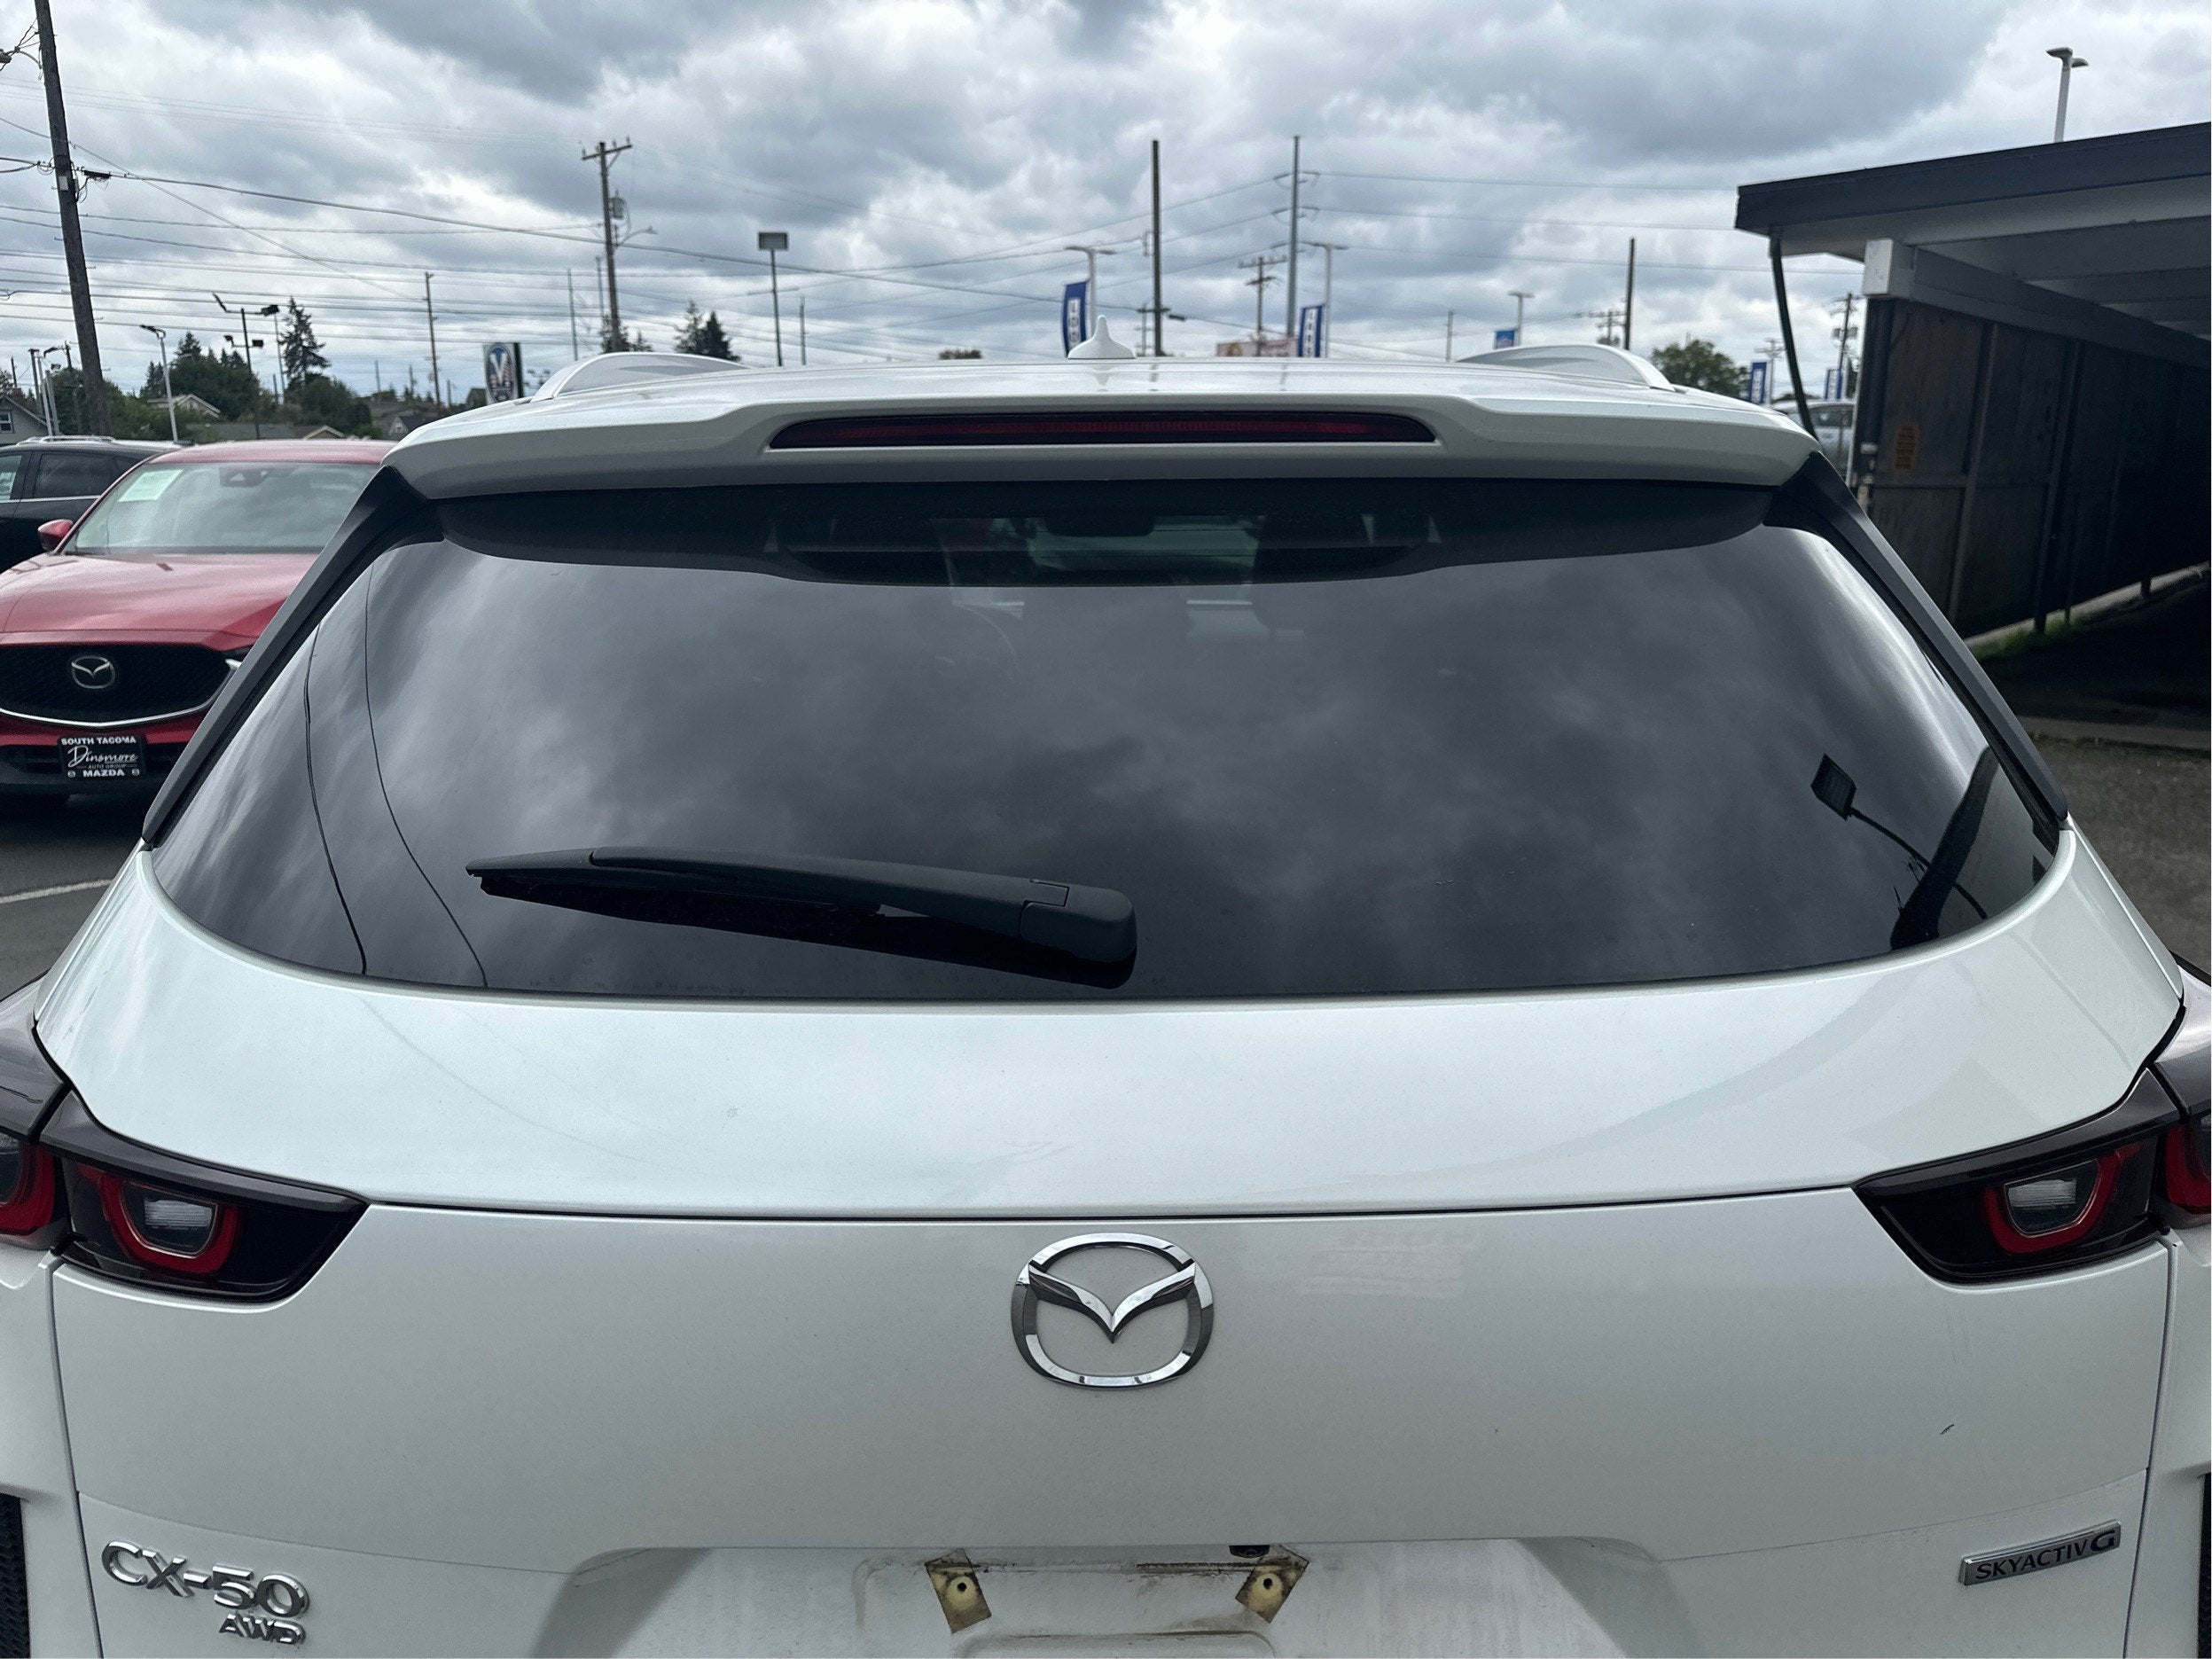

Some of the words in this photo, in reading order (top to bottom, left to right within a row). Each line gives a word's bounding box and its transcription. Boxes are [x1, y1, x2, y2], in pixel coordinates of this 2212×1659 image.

[61, 737, 94, 746] SOUTH
[97, 736, 137, 745] TACOMA
[67, 745, 138, 768] Dinsmore
[101, 1540, 310, 1618] CX-50
[218, 1613, 306, 1645] AWD
